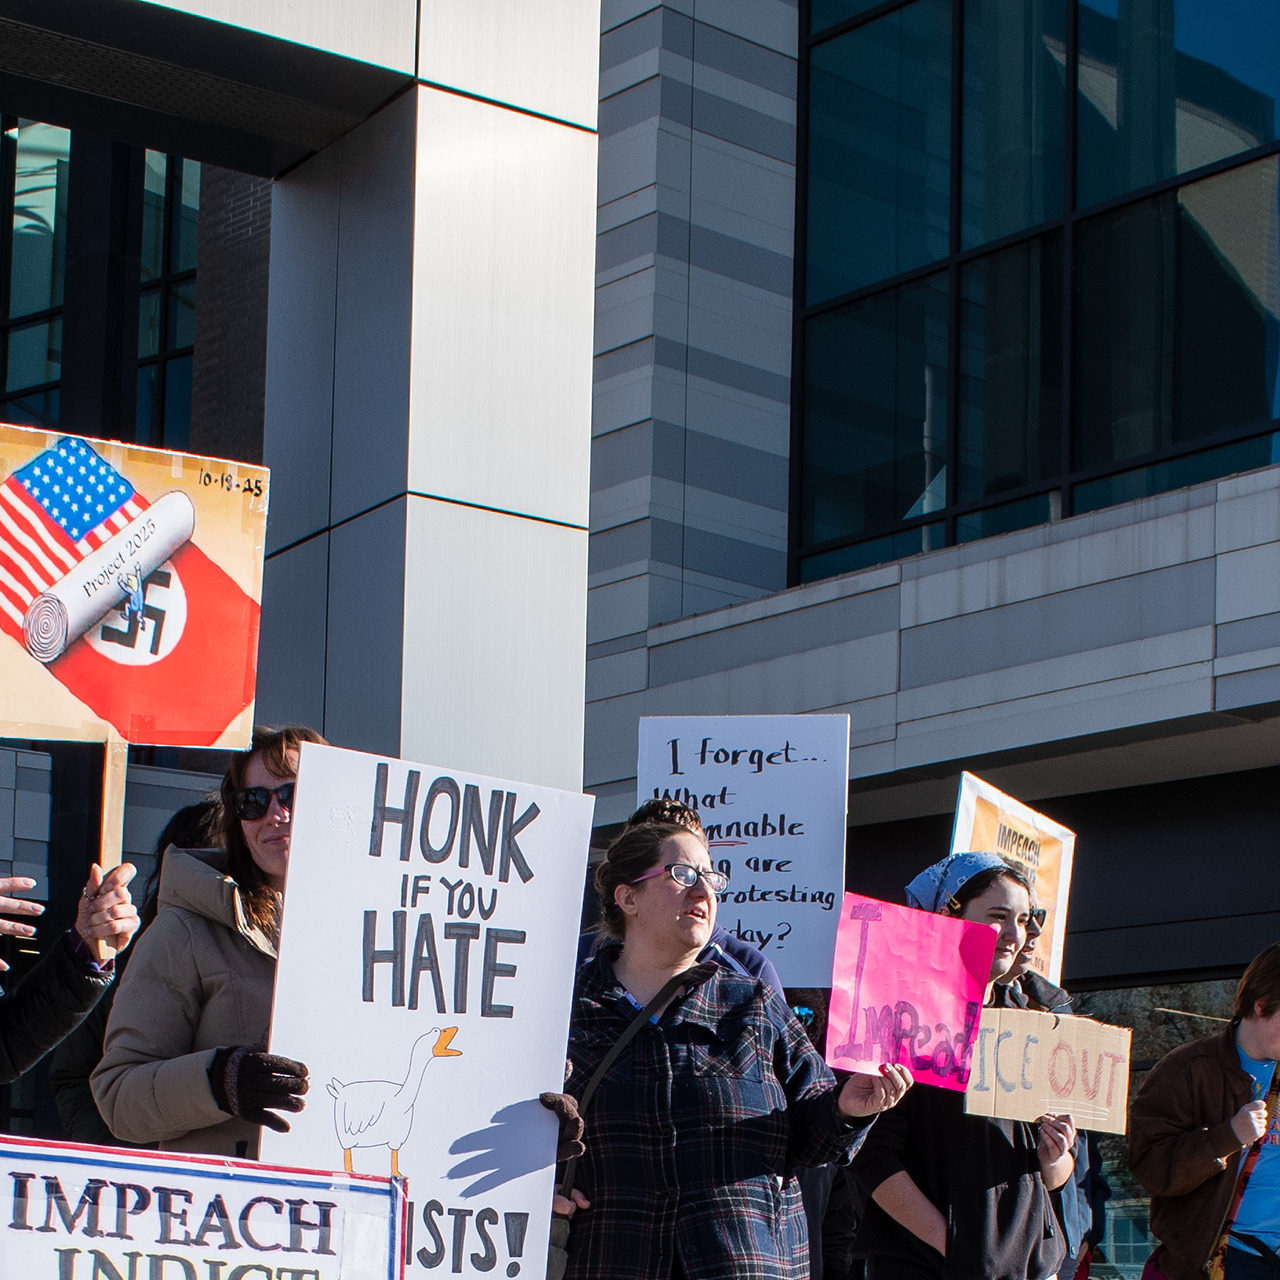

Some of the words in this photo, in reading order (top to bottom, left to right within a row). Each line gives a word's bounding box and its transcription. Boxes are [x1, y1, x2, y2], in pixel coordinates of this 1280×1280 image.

[82, 552, 126, 598] Project
[125, 518, 157, 557] 2025
[666, 737, 686, 776] I
[368, 762, 541, 884] HONK
[996, 822, 1041, 868] IMPEACH
[400, 873, 432, 910] IF
[438, 876, 499, 921] YOU
[744, 856, 794, 873] are
[361, 909, 527, 1019] HATE
[723, 918, 792, 952] day?
[973, 1027, 1039, 1093] ICE
[1047, 1038, 1127, 1108] OUT
[6, 1170, 339, 1257] IMPEACH
[405, 1198, 530, 1279] ISTS!
